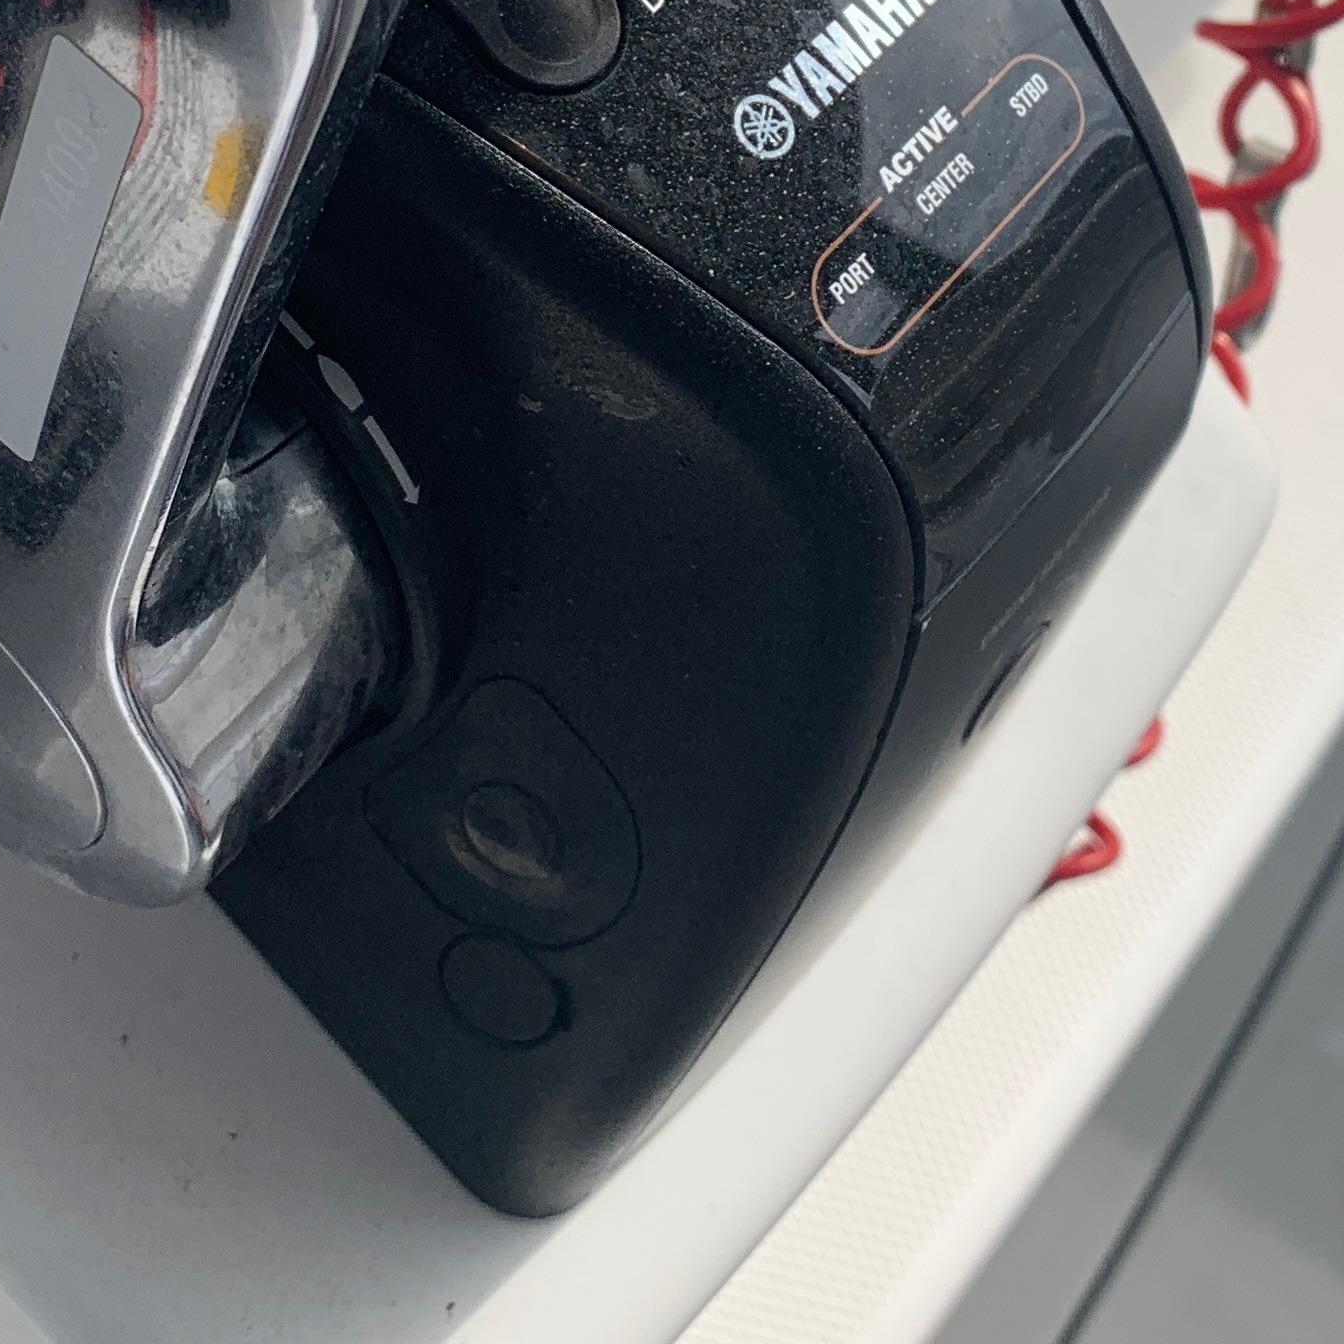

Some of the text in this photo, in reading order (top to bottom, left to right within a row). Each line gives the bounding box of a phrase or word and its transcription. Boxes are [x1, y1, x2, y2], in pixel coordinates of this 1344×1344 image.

[1009, 72, 1049, 118] STBD
[879, 105, 958, 194] ACTIVE
[915, 152, 975, 216] CENTER
[829, 252, 875, 305] PORT
